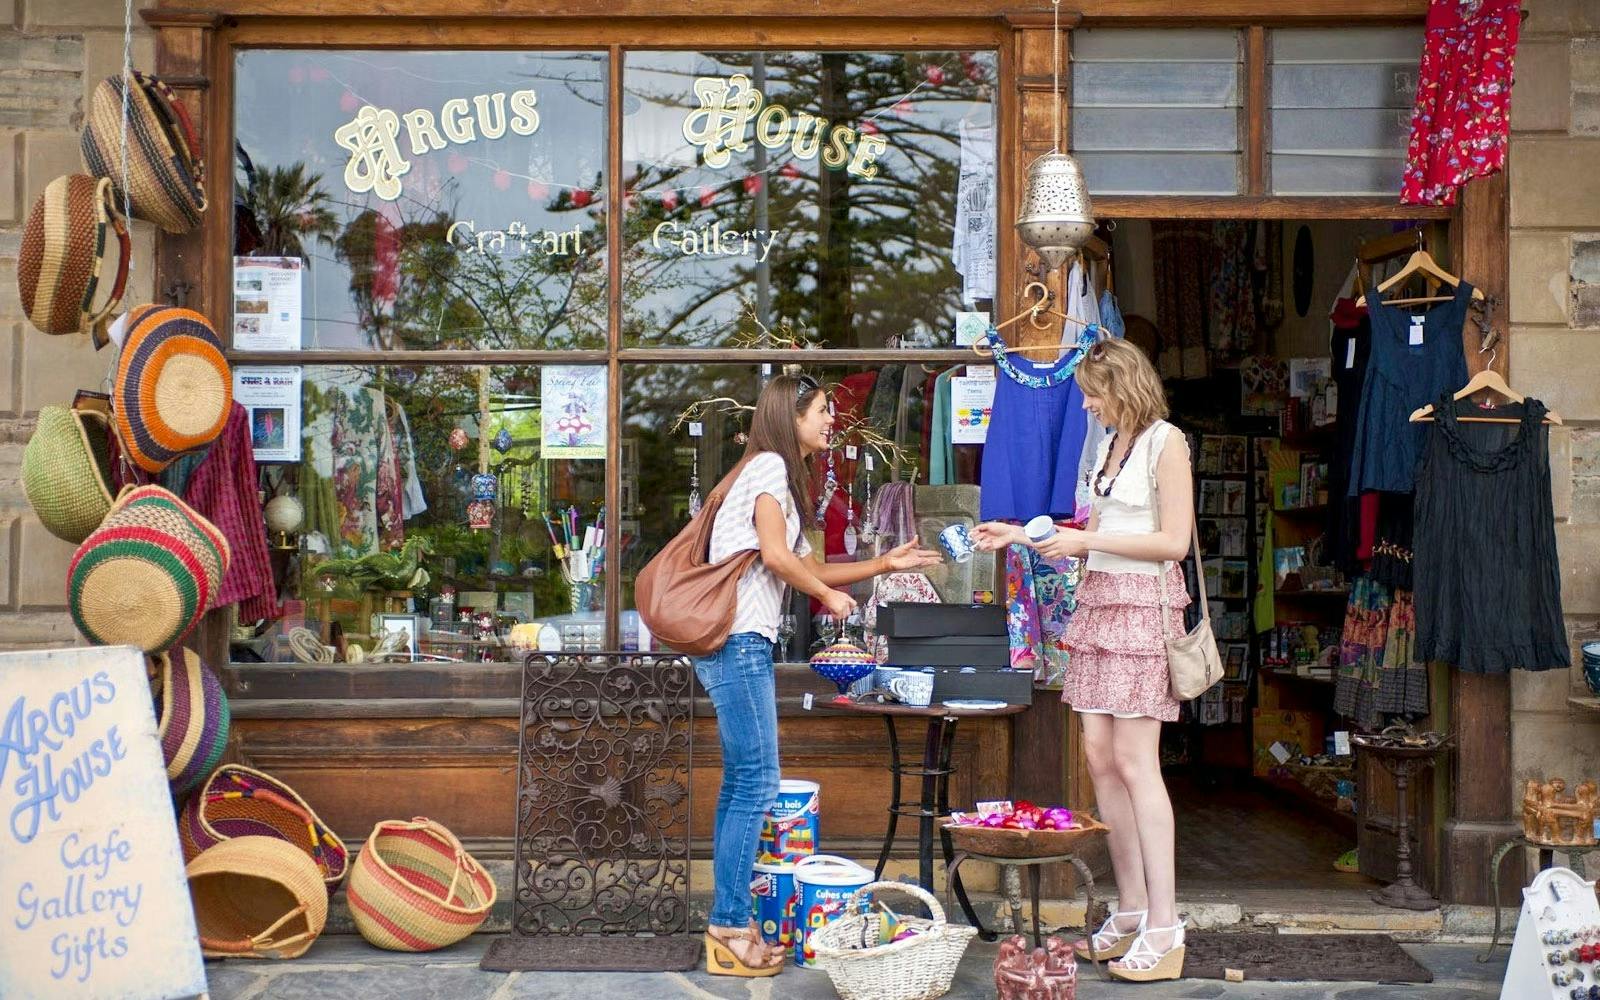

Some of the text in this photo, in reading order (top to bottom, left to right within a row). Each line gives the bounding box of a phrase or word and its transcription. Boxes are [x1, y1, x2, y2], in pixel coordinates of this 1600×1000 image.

[335, 73, 887, 201] ARGUS HOUSE
[446, 219, 780, 264] Craft-art Gallery
[0, 670, 117, 785] ARGUS
[10, 724, 128, 844] HOUSE
[784, 799, 802, 809] bois
[60, 828, 132, 881] Cafe
[14, 873, 143, 931] Gallery
[50, 926, 129, 983] Gifts
